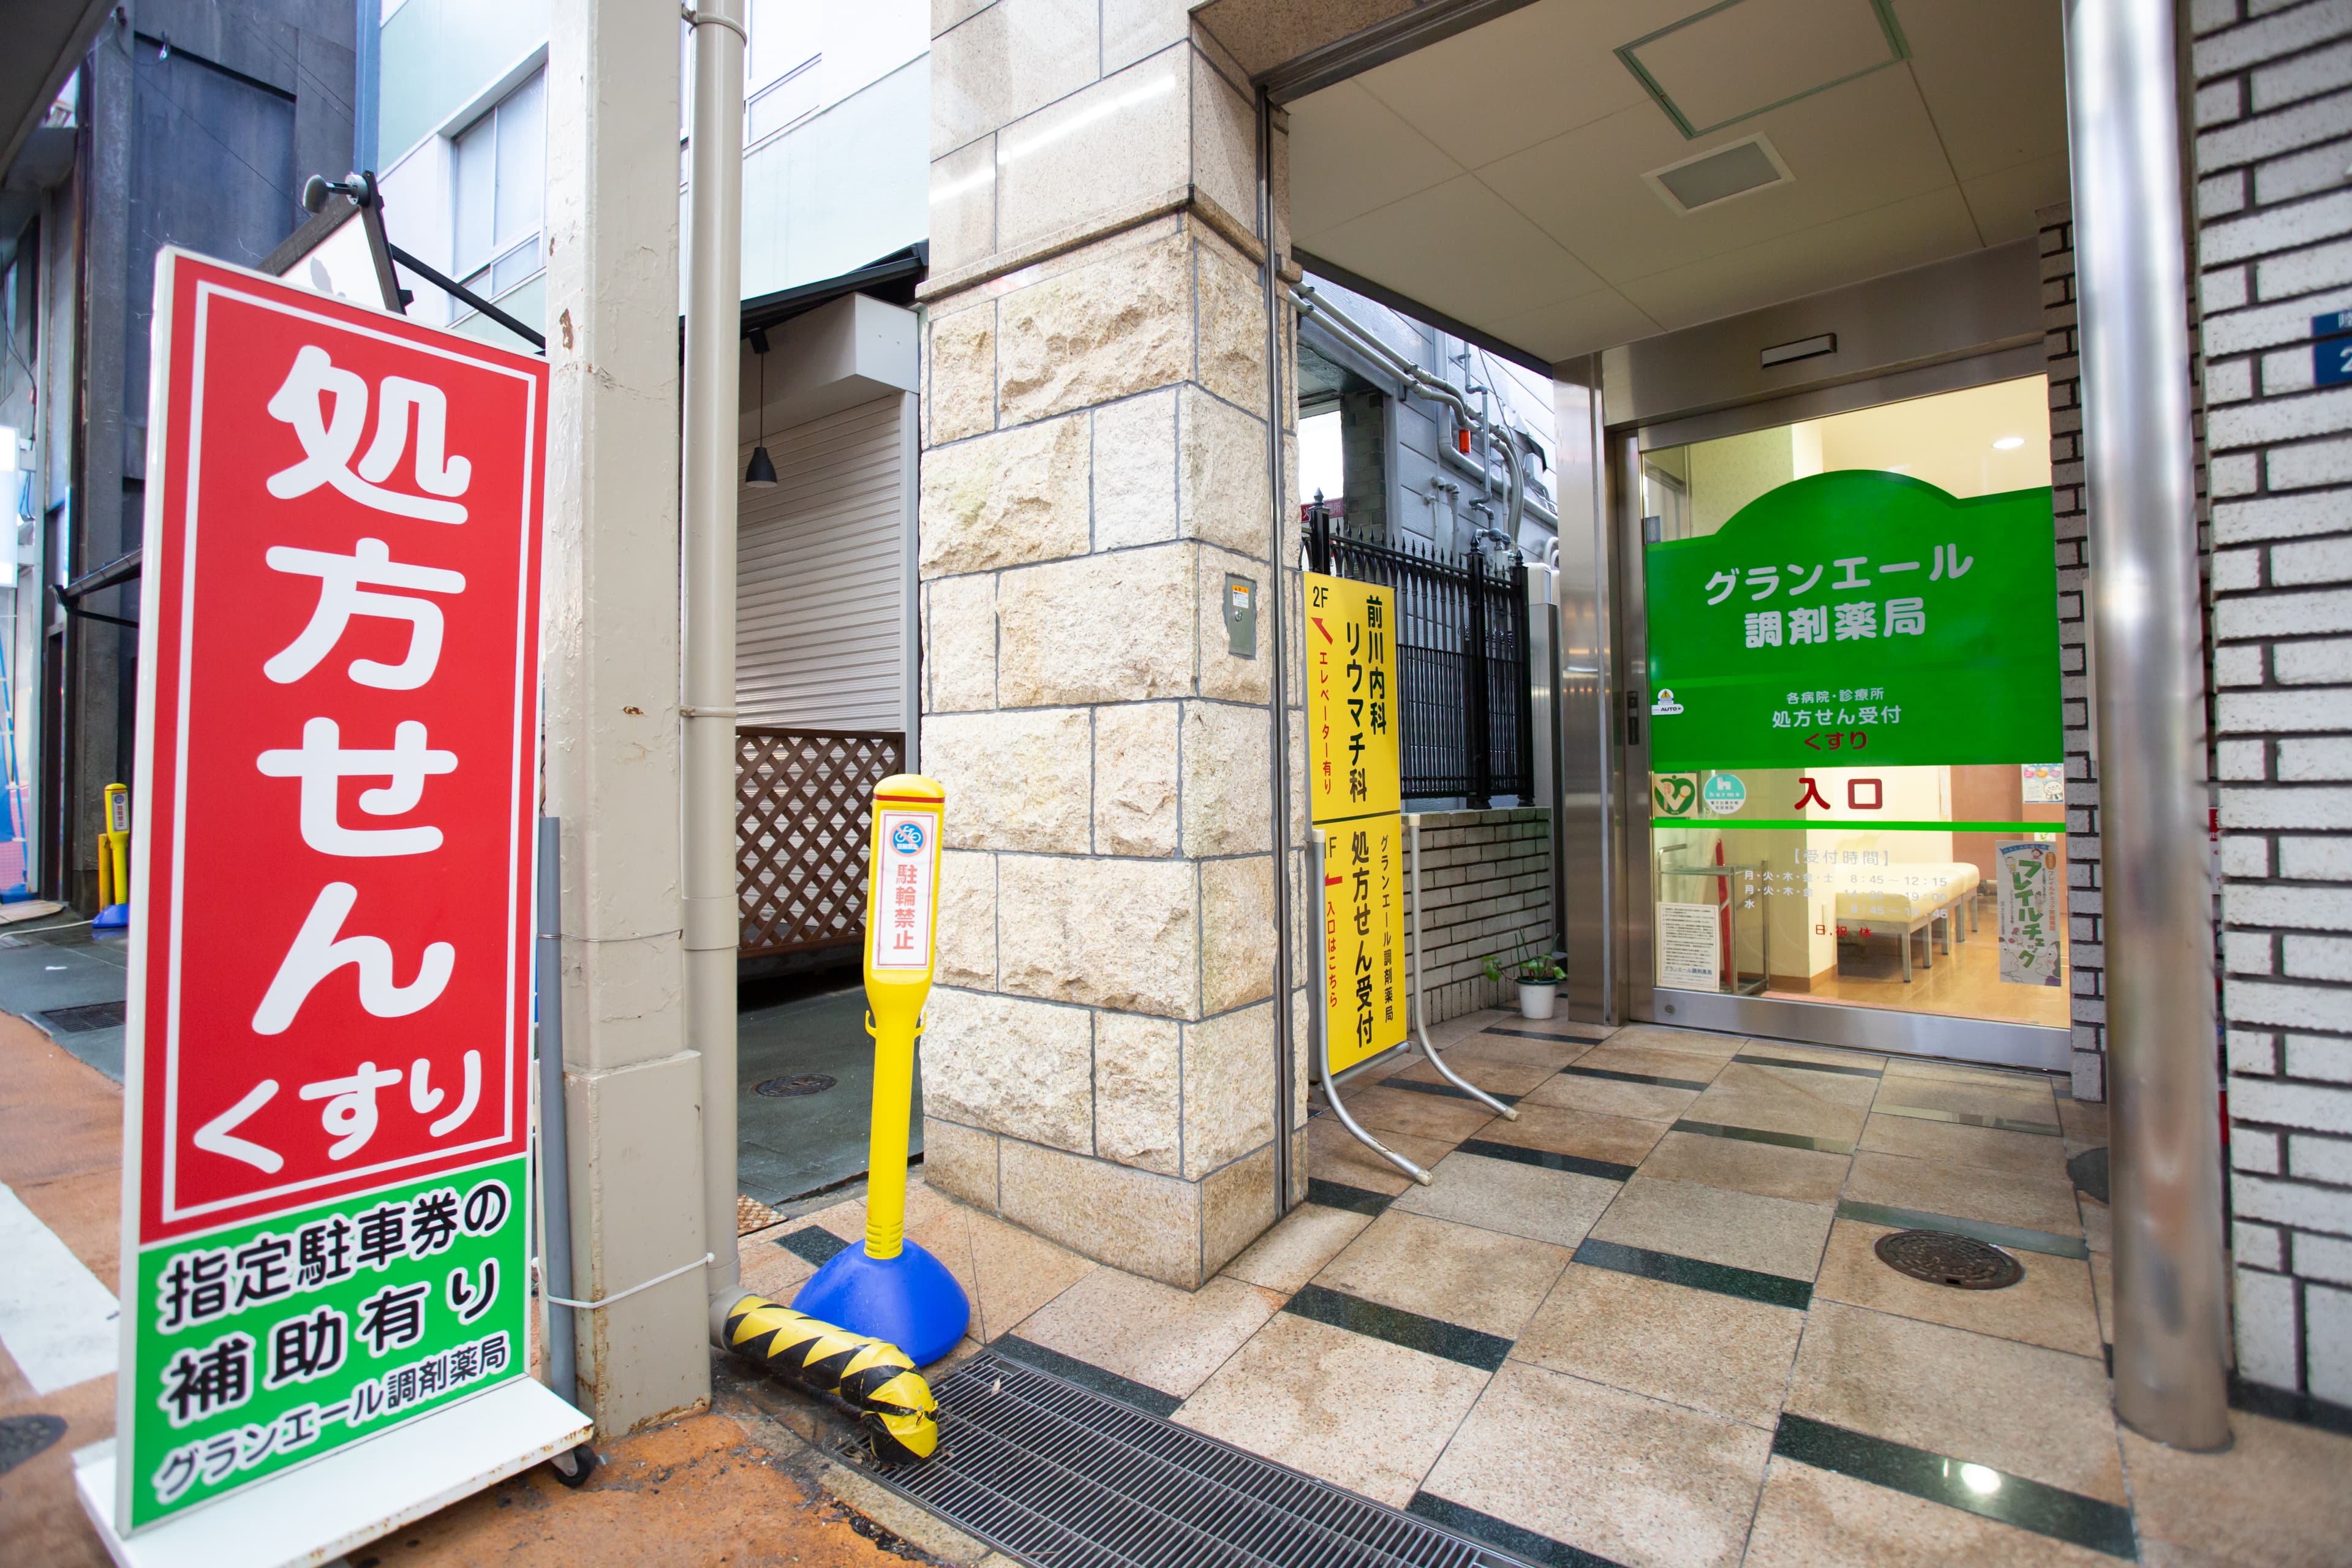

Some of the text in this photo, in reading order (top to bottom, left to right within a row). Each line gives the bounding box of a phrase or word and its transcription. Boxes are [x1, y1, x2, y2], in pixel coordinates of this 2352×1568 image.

[1313, 586, 1329, 608] 2F
[1705, 543, 1973, 605] グランエール
[1745, 597, 1925, 648] 調剤薬局
[252, 345, 472, 1035] 処方せん
[1347, 622, 1366, 802] リウマチ科
[1366, 595, 1386, 734] 前川内科
[1772, 705, 1901, 728] 処方せん受付
[1787, 687, 1884, 704] 各病院・診療所
[1320, 652, 1332, 794] エレベーター有り
[1804, 731, 1867, 750] くすり
[1794, 777, 1883, 810] 入口
[893, 864, 918, 950] 駐輪禁止
[1327, 901, 1337, 1008] 入口はこちら
[1351, 831, 1373, 1048] 処方せん受付
[1381, 835, 1394, 1023] グランエール調剤薬局
[1744, 899, 1755, 909] 水
[194, 1049, 482, 1174] くすり
[165, 1185, 507, 1327] 指定駐車券の
[167, 1263, 495, 1419] 補助有り
[158, 1336, 506, 1495] グランエール調剤薬局
